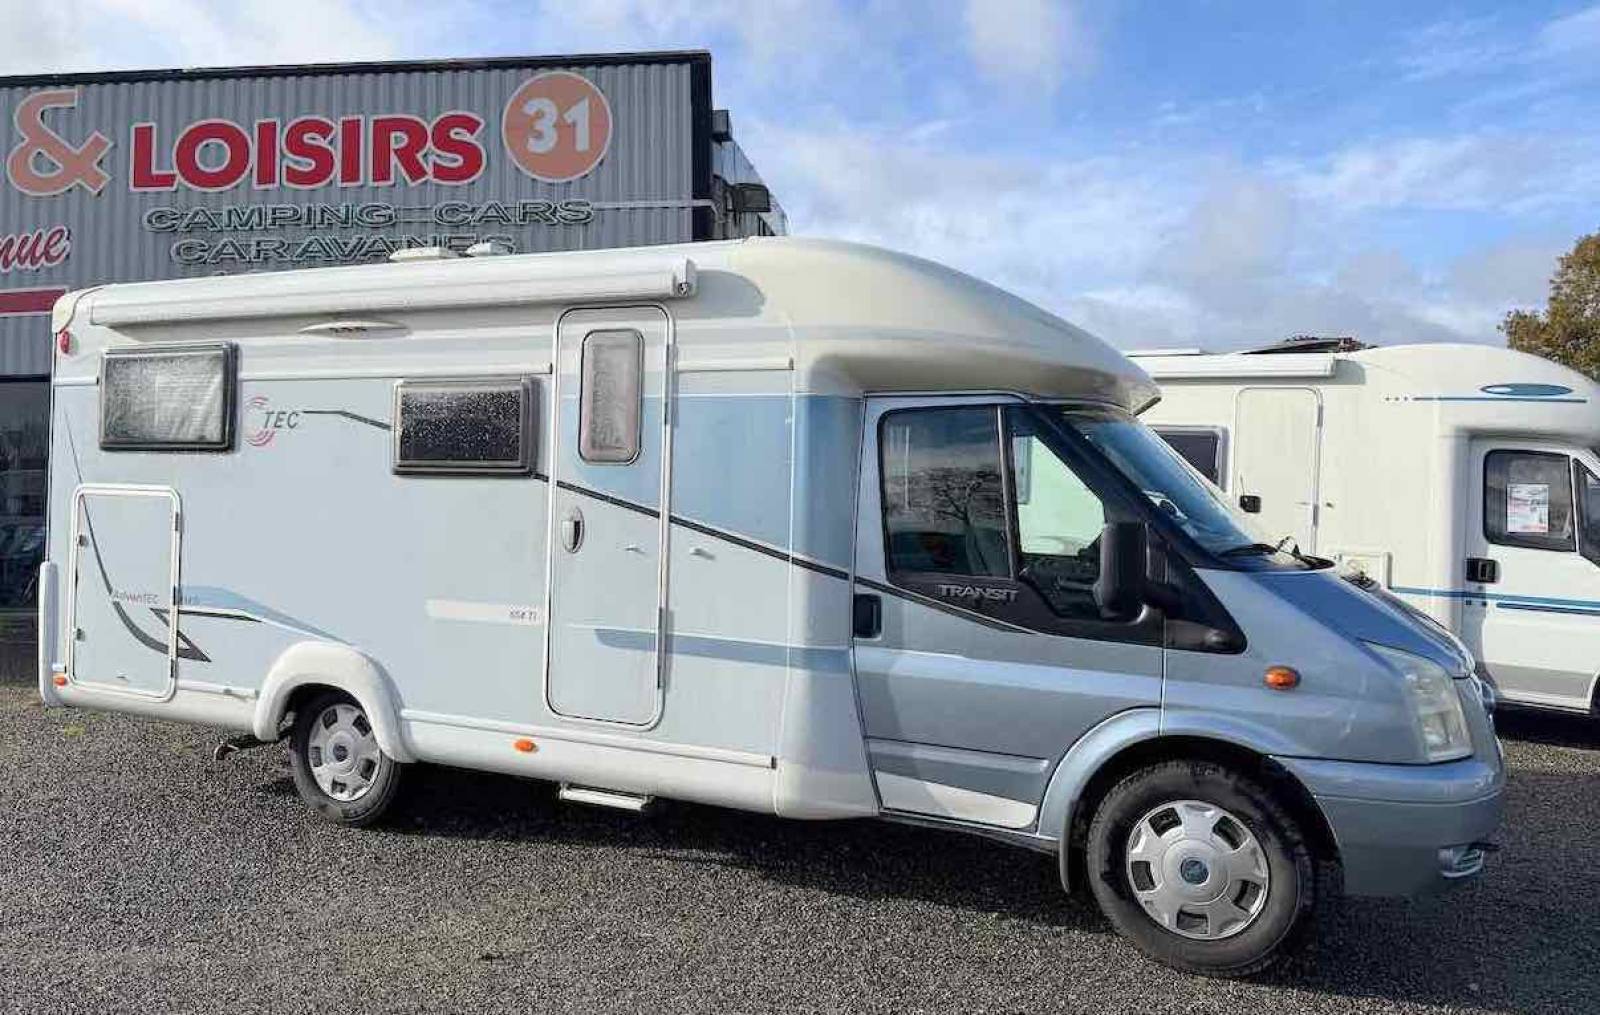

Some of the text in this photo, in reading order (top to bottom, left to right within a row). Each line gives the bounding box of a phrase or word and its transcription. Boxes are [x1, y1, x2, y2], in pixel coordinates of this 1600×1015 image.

[518, 97, 593, 154] 31
[130, 111, 486, 193] LOISIRS
[434, 200, 594, 226] CARS
[263, 410, 298, 429] TEC
[939, 583, 1019, 602] TRANSIT
